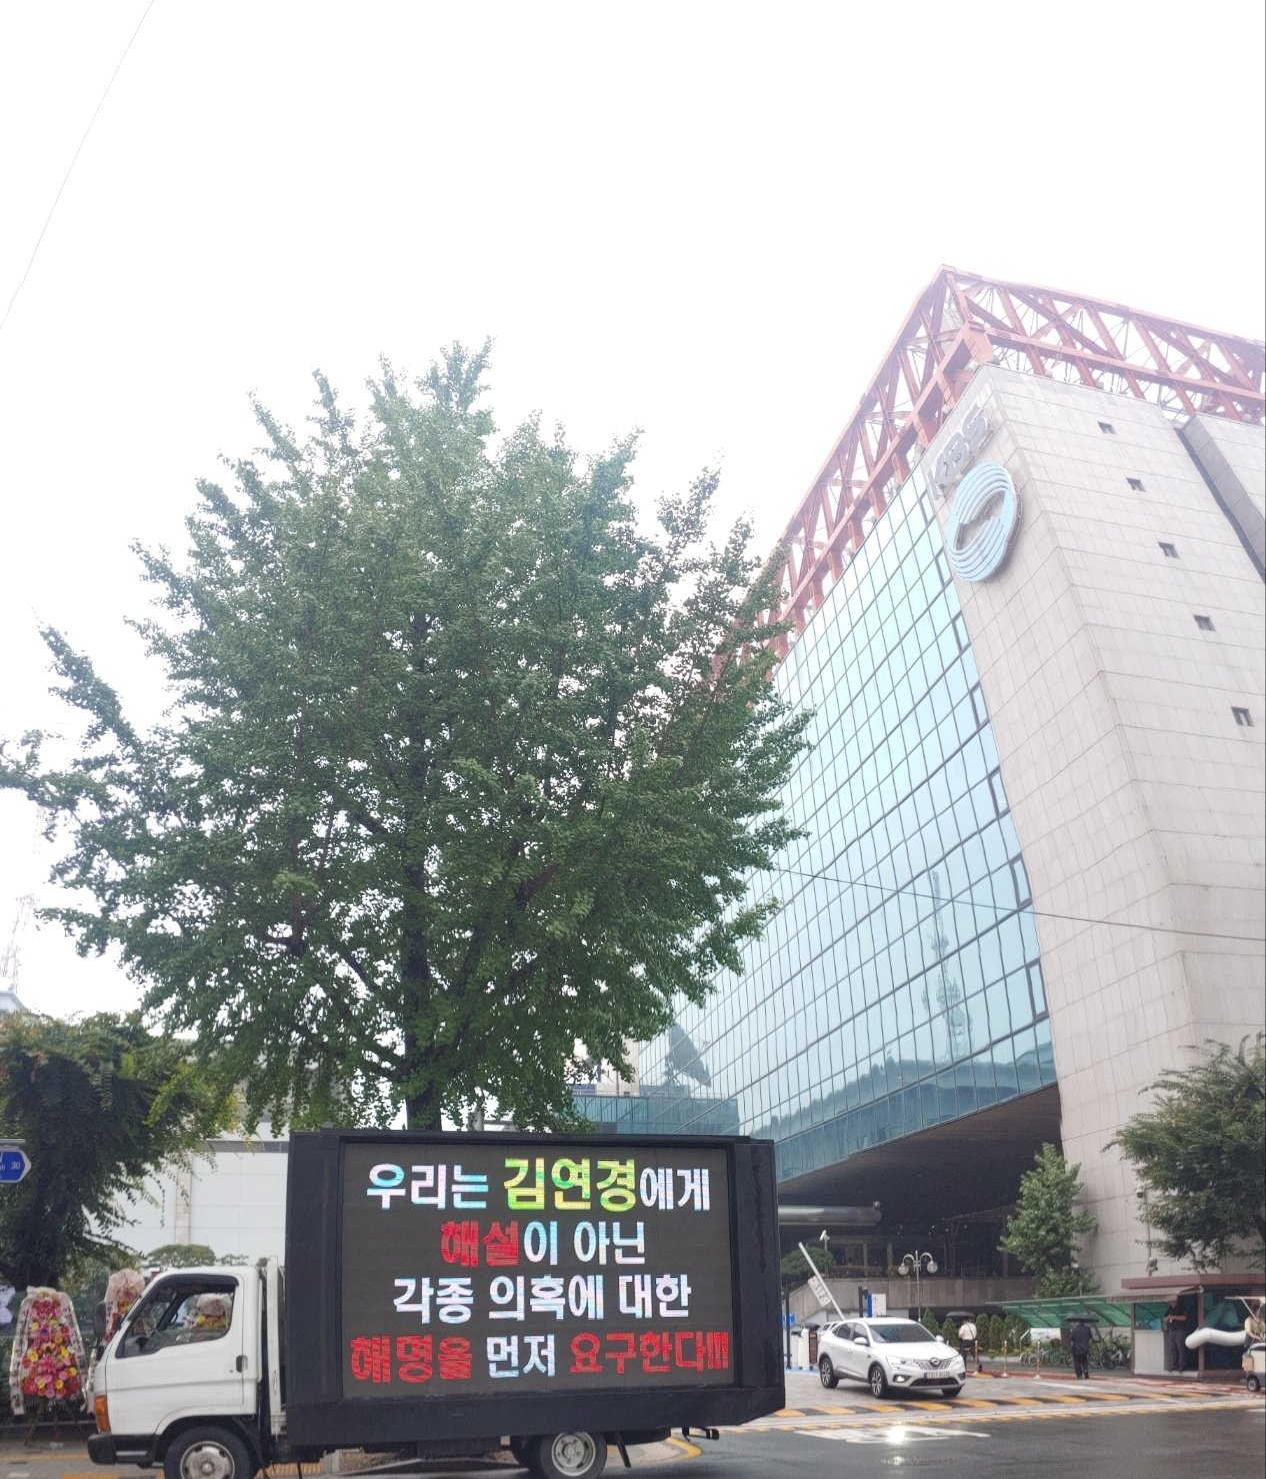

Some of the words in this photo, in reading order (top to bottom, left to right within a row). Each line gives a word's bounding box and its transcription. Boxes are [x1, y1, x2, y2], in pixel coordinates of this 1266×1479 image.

[926, 403, 990, 500] KBS
[367, 1163, 489, 1210] 우리는
[504, 1158, 711, 1212] 김연경에게
[440, 1220, 559, 1267] 해설이
[574, 1221, 646, 1265] 아닌
[393, 1276, 474, 1324] 각종
[489, 1274, 604, 1321] 의혹에
[619, 1273, 692, 1319] 대한
[351, 1334, 473, 1383] 해명을
[487, 1334, 556, 1378] 먼저
